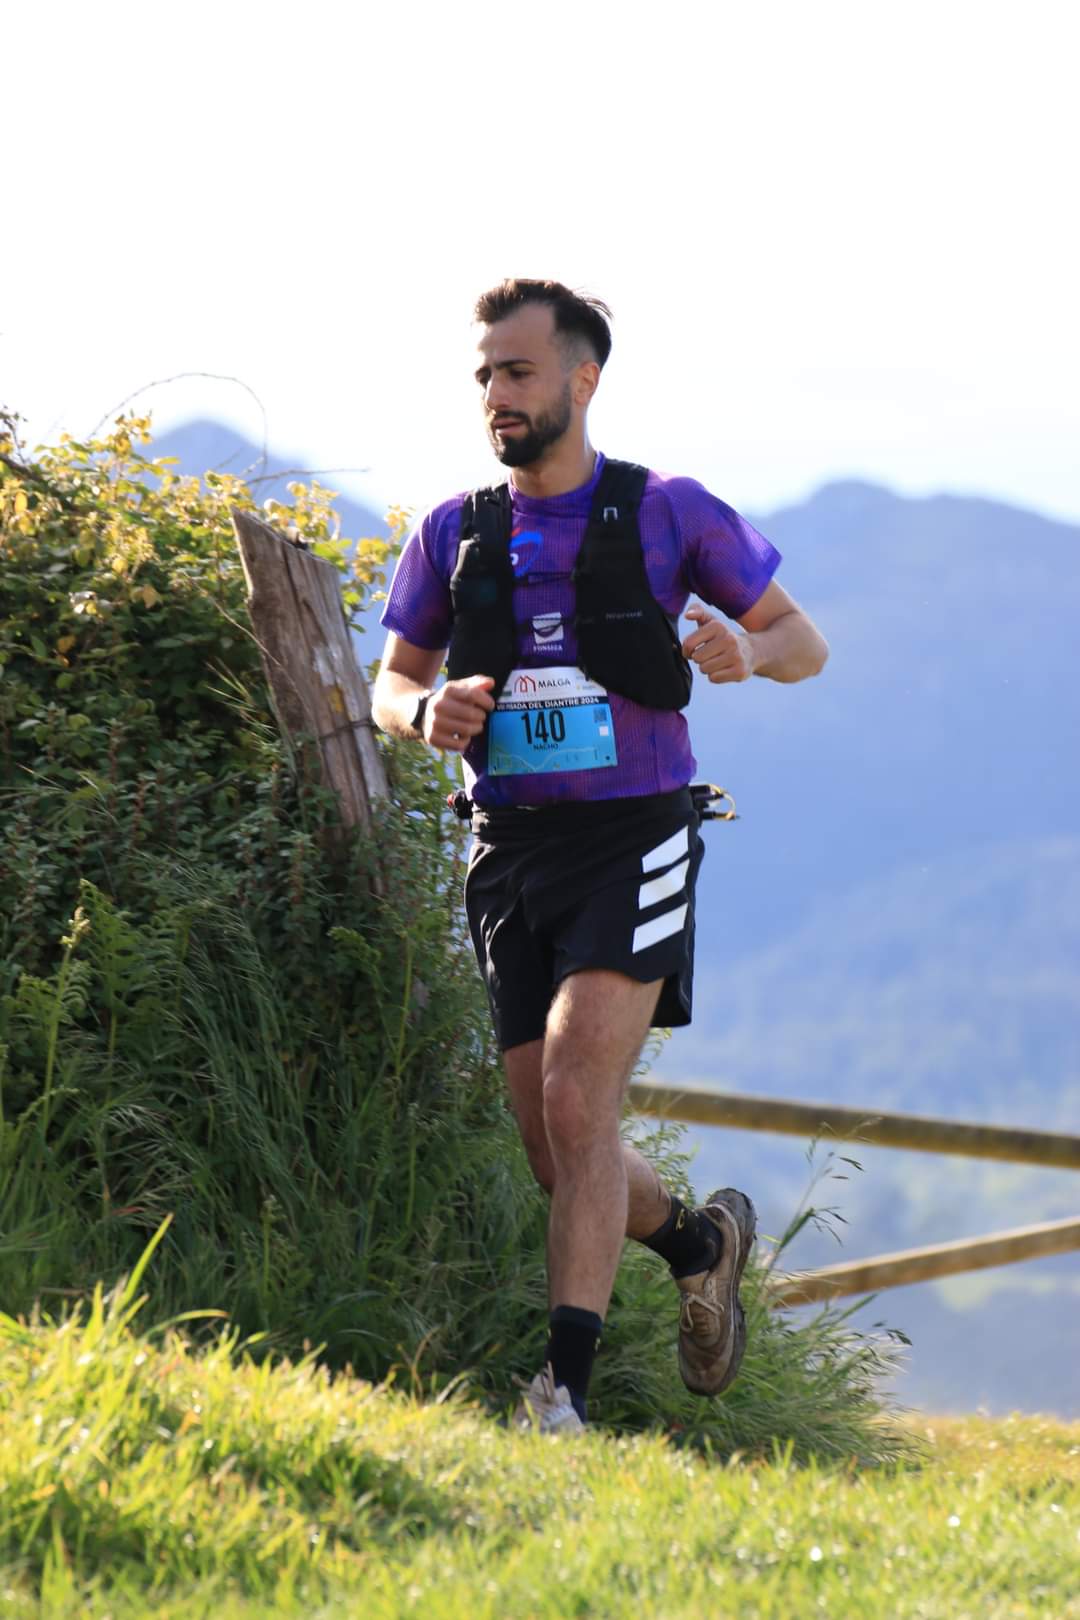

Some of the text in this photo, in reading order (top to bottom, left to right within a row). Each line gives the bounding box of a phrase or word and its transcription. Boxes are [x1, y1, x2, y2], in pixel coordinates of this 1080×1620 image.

[538, 679, 571, 688] MALGA
[545, 698, 579, 708] DIANTRE
[521, 709, 566, 745] 140
